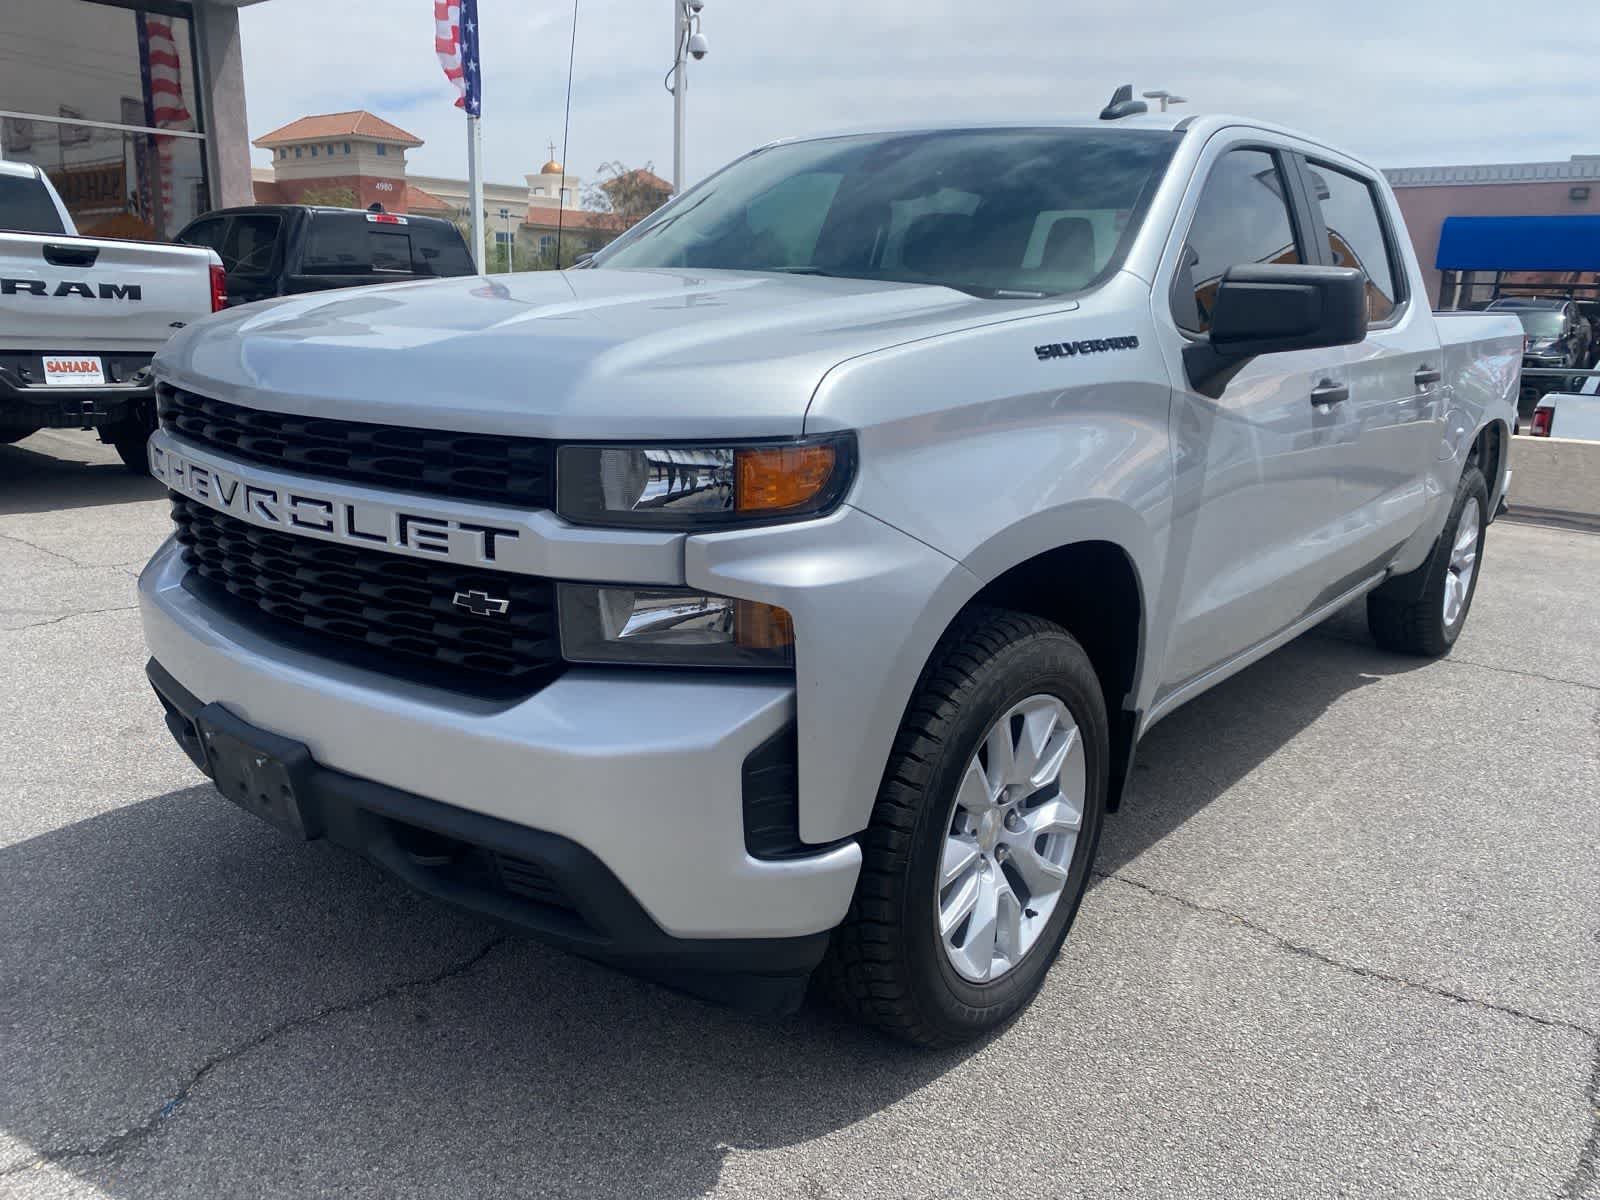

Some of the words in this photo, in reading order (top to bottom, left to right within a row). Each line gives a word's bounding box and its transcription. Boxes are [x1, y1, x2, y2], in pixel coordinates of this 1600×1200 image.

[0, 279, 142, 300] RAM
[1034, 335, 1140, 361] SILVERADO
[46, 361, 99, 373] SAHARA
[150, 445, 520, 562] CHEVROLET
